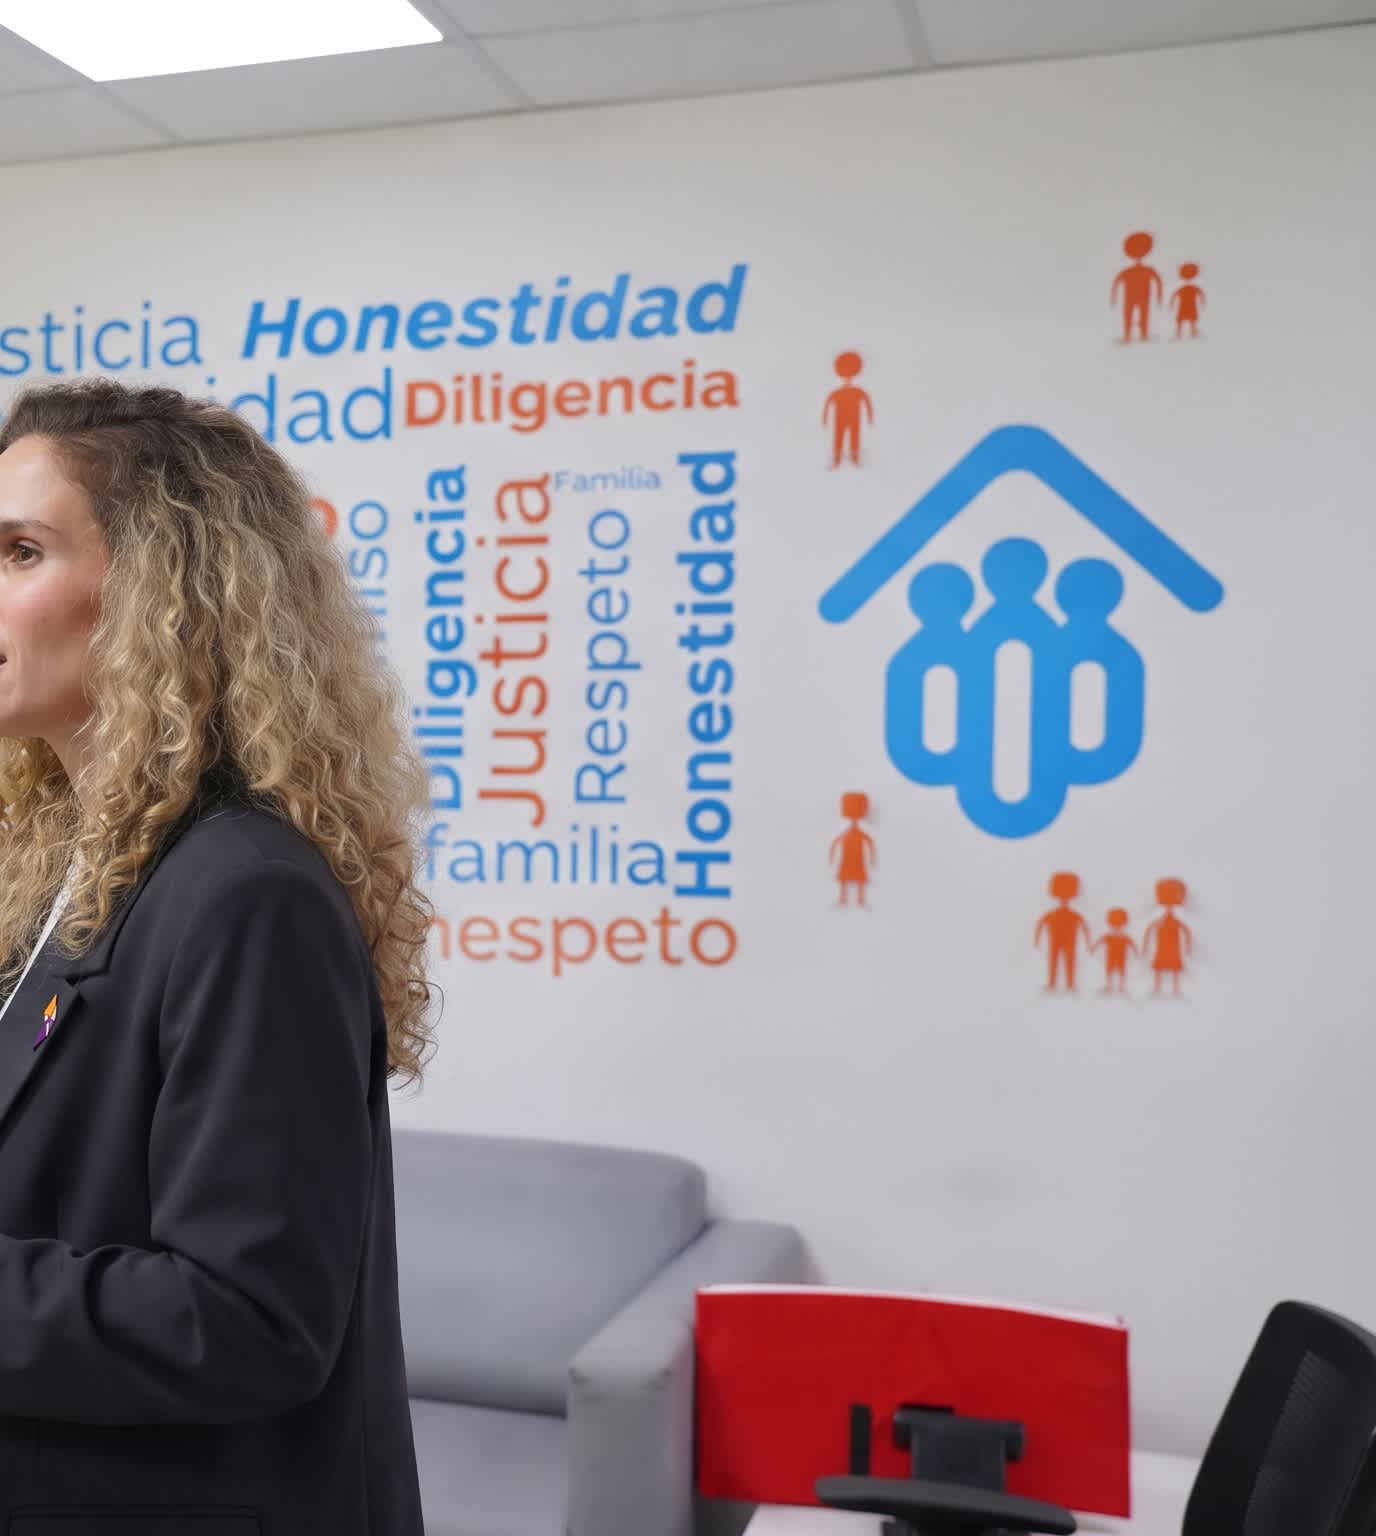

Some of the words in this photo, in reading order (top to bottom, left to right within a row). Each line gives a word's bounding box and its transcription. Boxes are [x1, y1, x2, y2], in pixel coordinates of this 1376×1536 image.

[241, 263, 749, 360] Honestidad
[405, 360, 738, 433] Diligencia
[554, 467, 662, 494] Familia
[413, 465, 478, 812] Diligencia
[476, 474, 550, 827] Justicia
[573, 508, 642, 805] Respeto
[673, 450, 737, 900] Honestidad
[424, 822, 669, 888] familia
